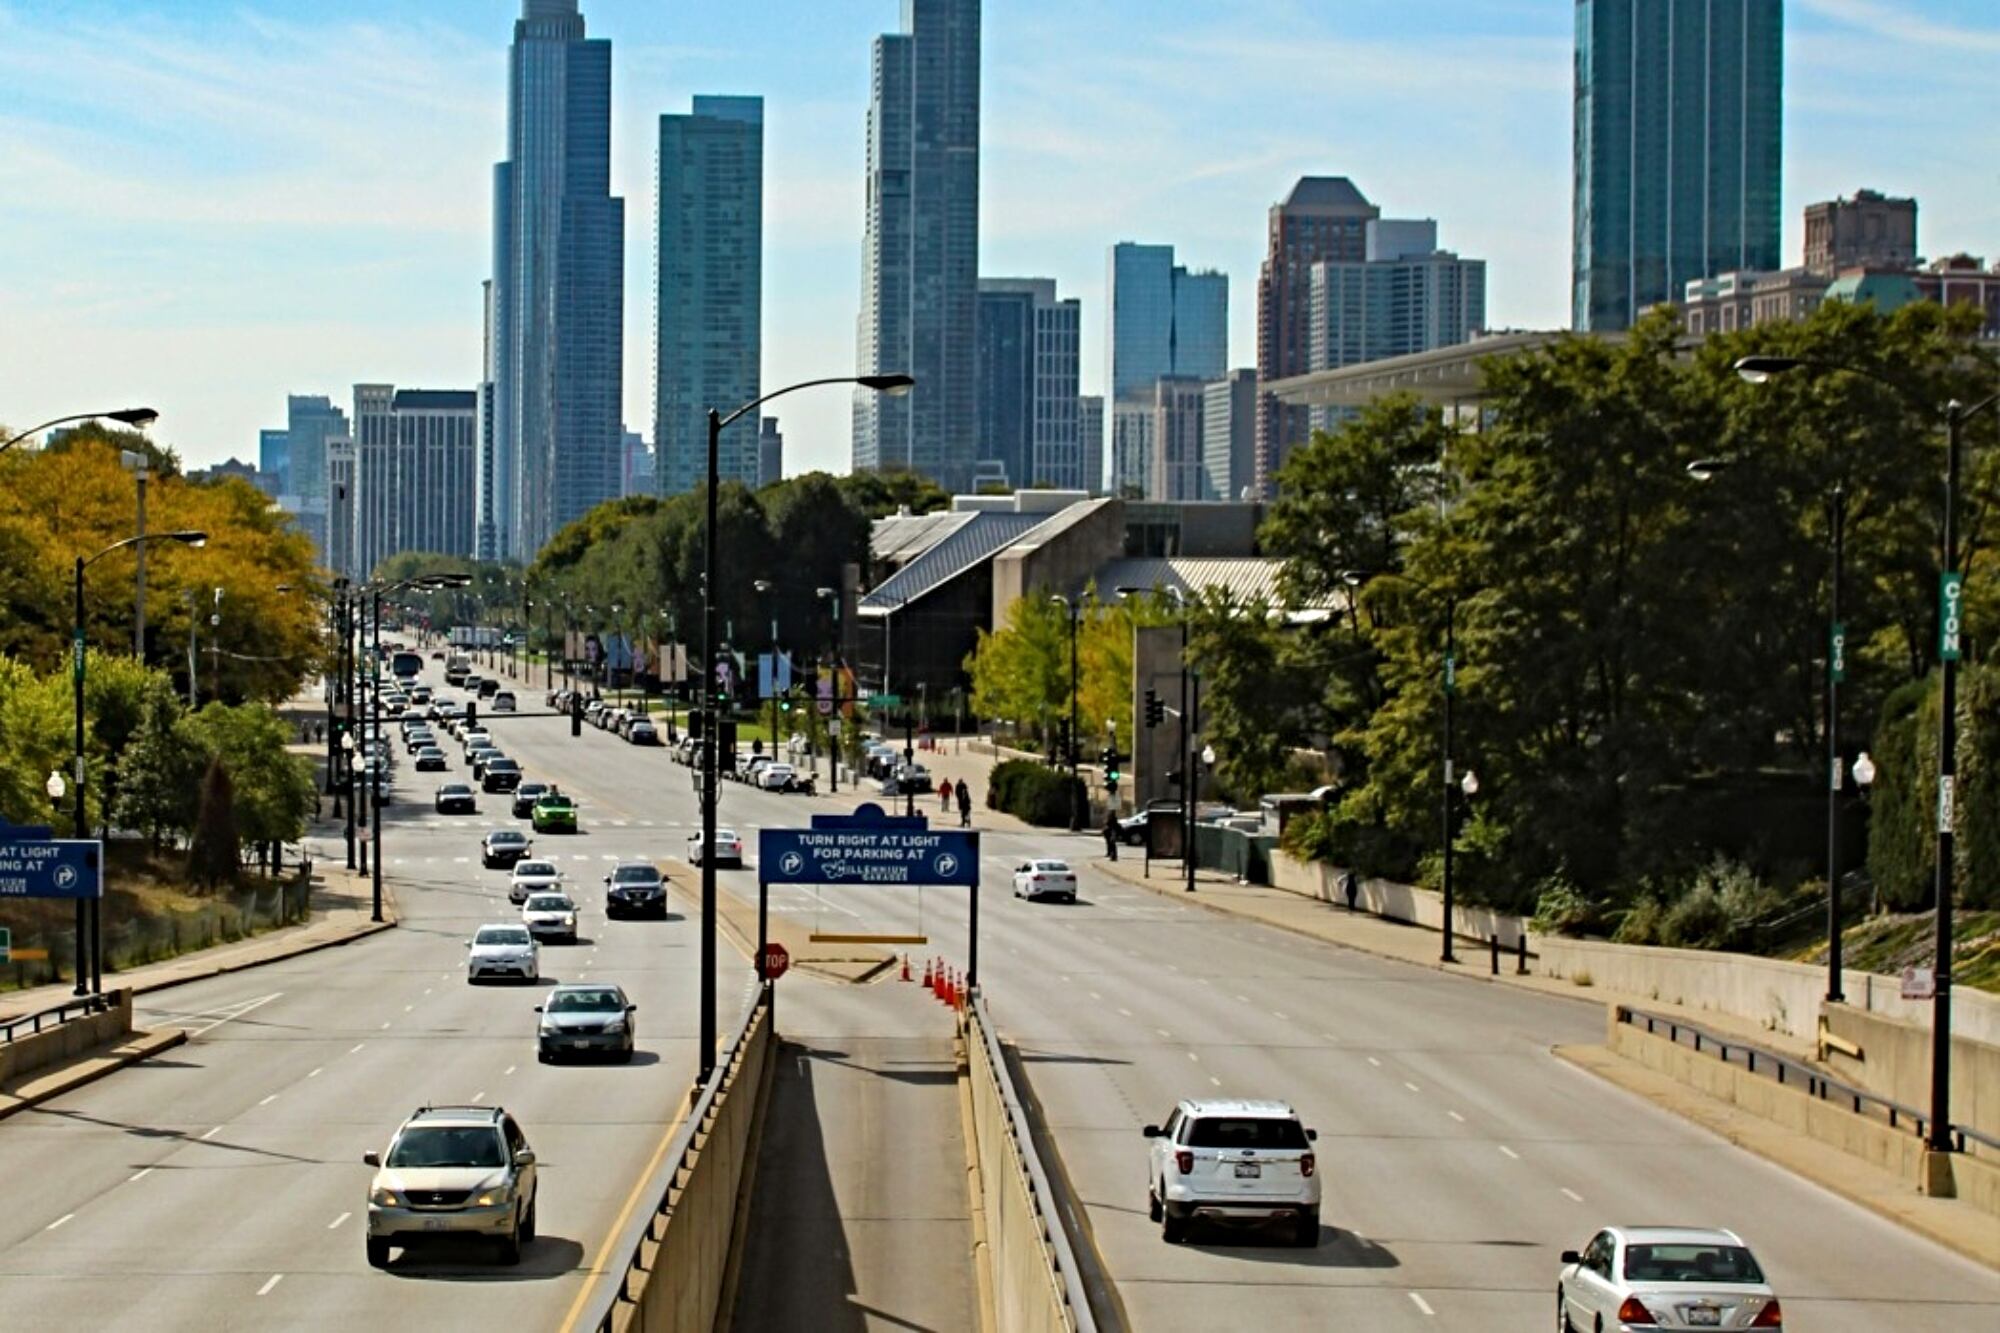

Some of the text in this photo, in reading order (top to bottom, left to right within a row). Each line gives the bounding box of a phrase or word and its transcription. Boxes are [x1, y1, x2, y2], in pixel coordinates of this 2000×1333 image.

[1943, 582, 1960, 651] C10N
[798, 834, 941, 847] TURN RIGHT AT LIGHT
[20, 847, 60, 858] LIGHT
[813, 848, 926, 861] FOR PARKING AT
[26, 860, 44, 872] AT
